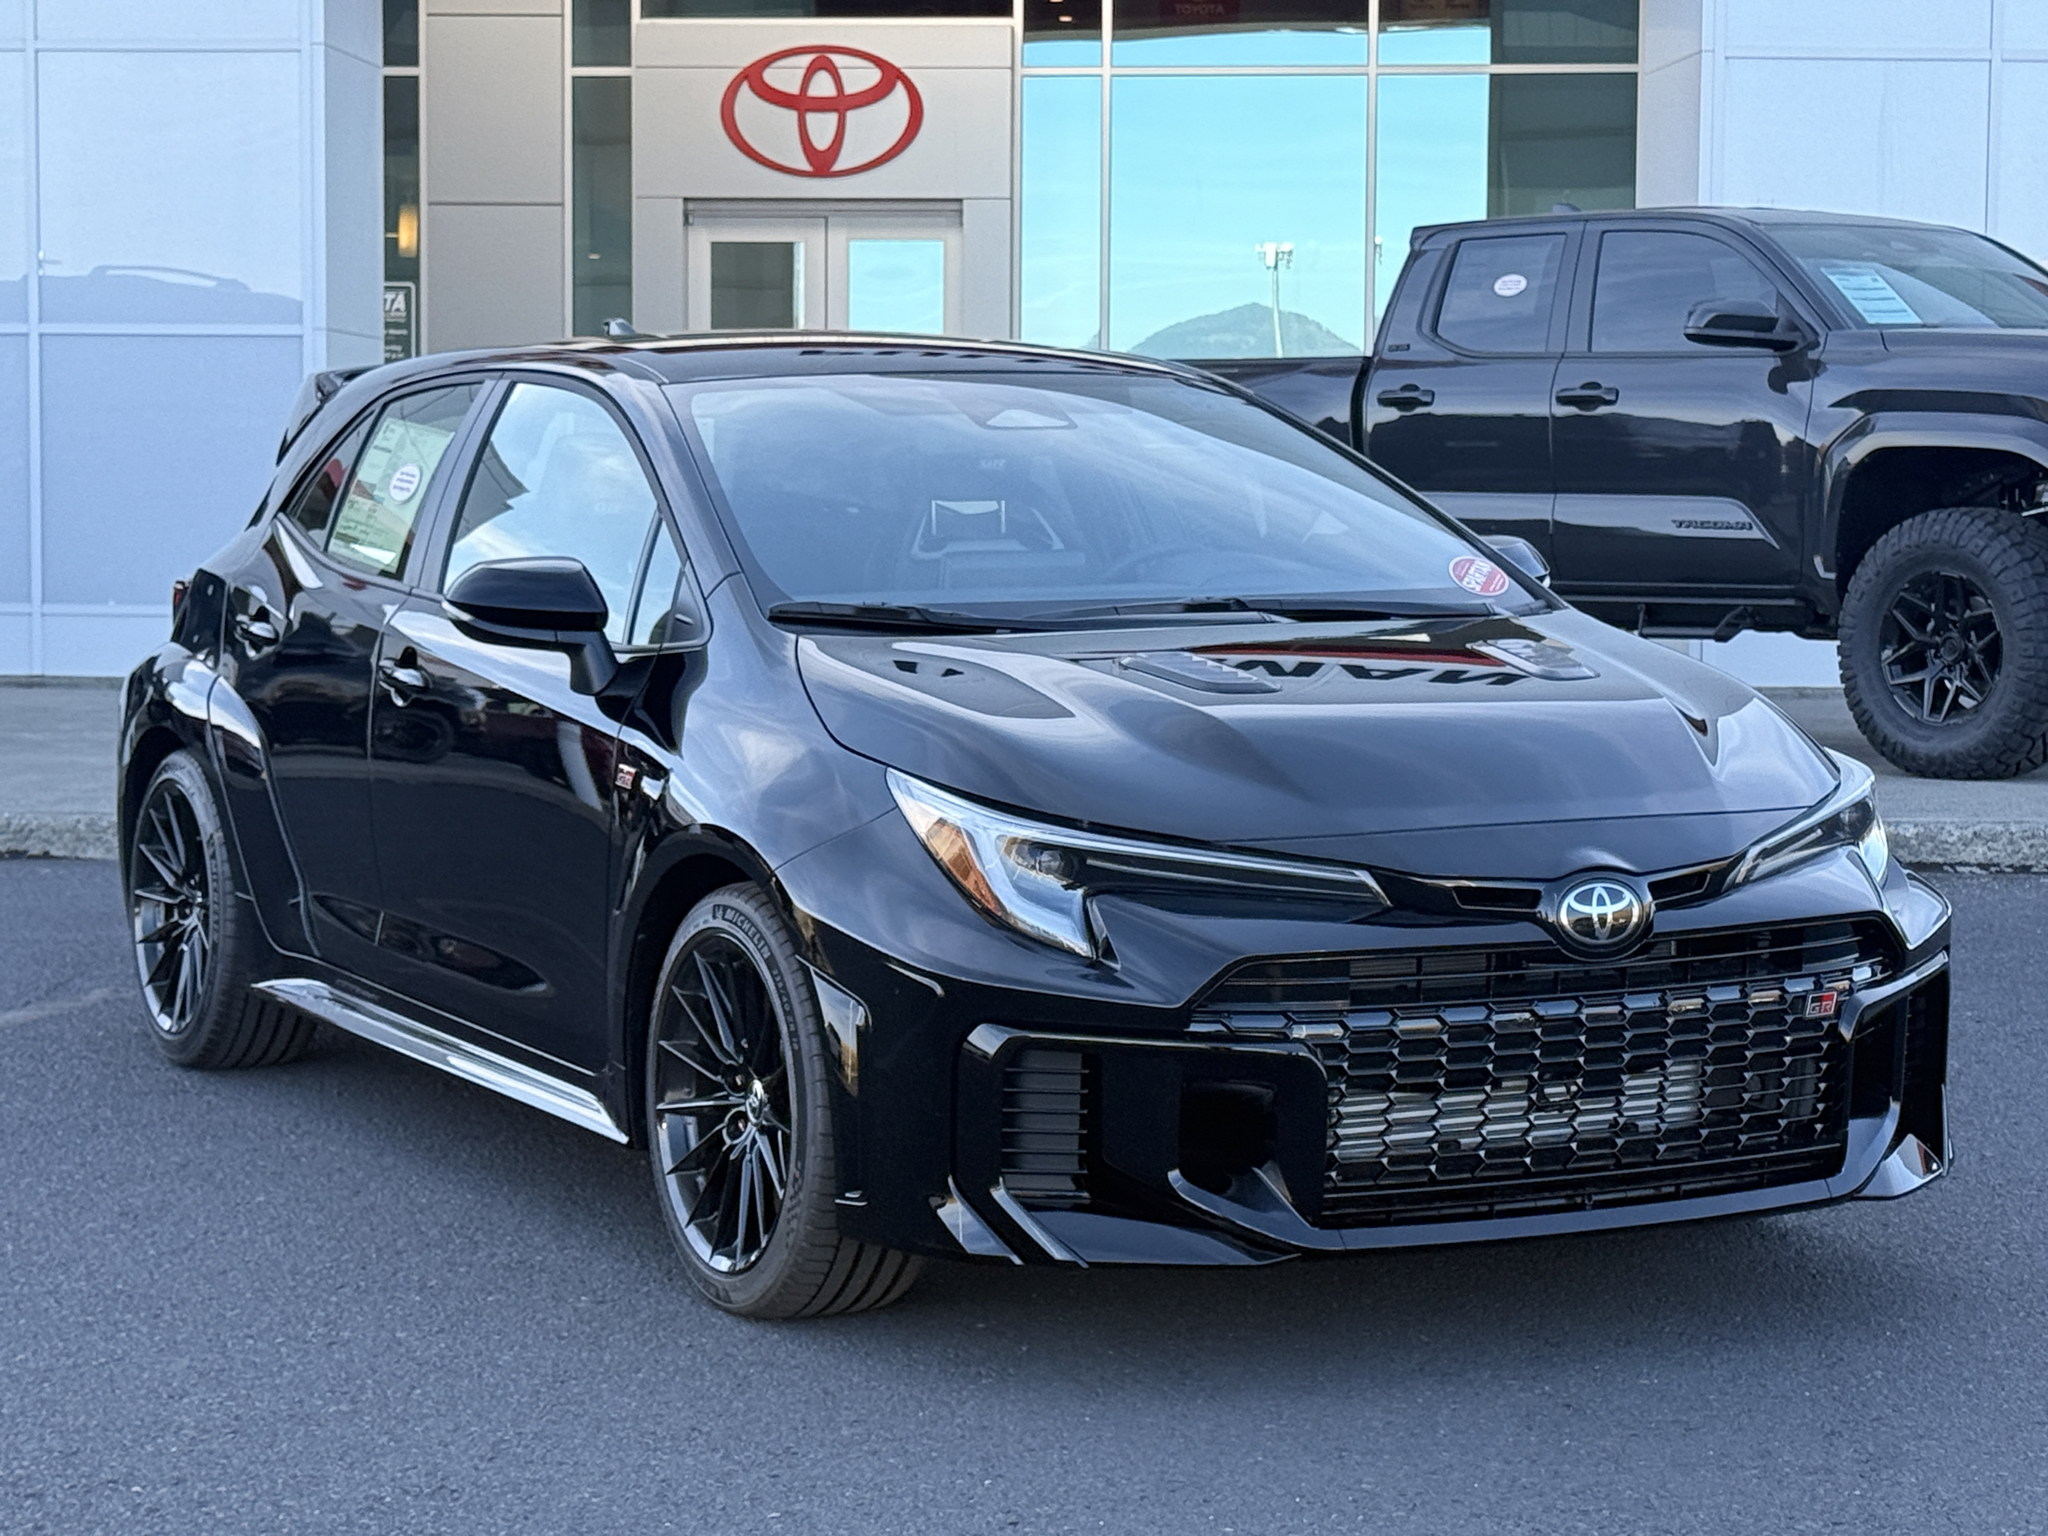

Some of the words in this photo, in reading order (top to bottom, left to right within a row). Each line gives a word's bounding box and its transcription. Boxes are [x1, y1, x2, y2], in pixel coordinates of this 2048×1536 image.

[1175, 3, 1223, 15] TOYOTA
[1671, 519, 1753, 531] TACOMA
[724, 907, 771, 960] MICHELIN
[1810, 1001, 1833, 1014] GR
